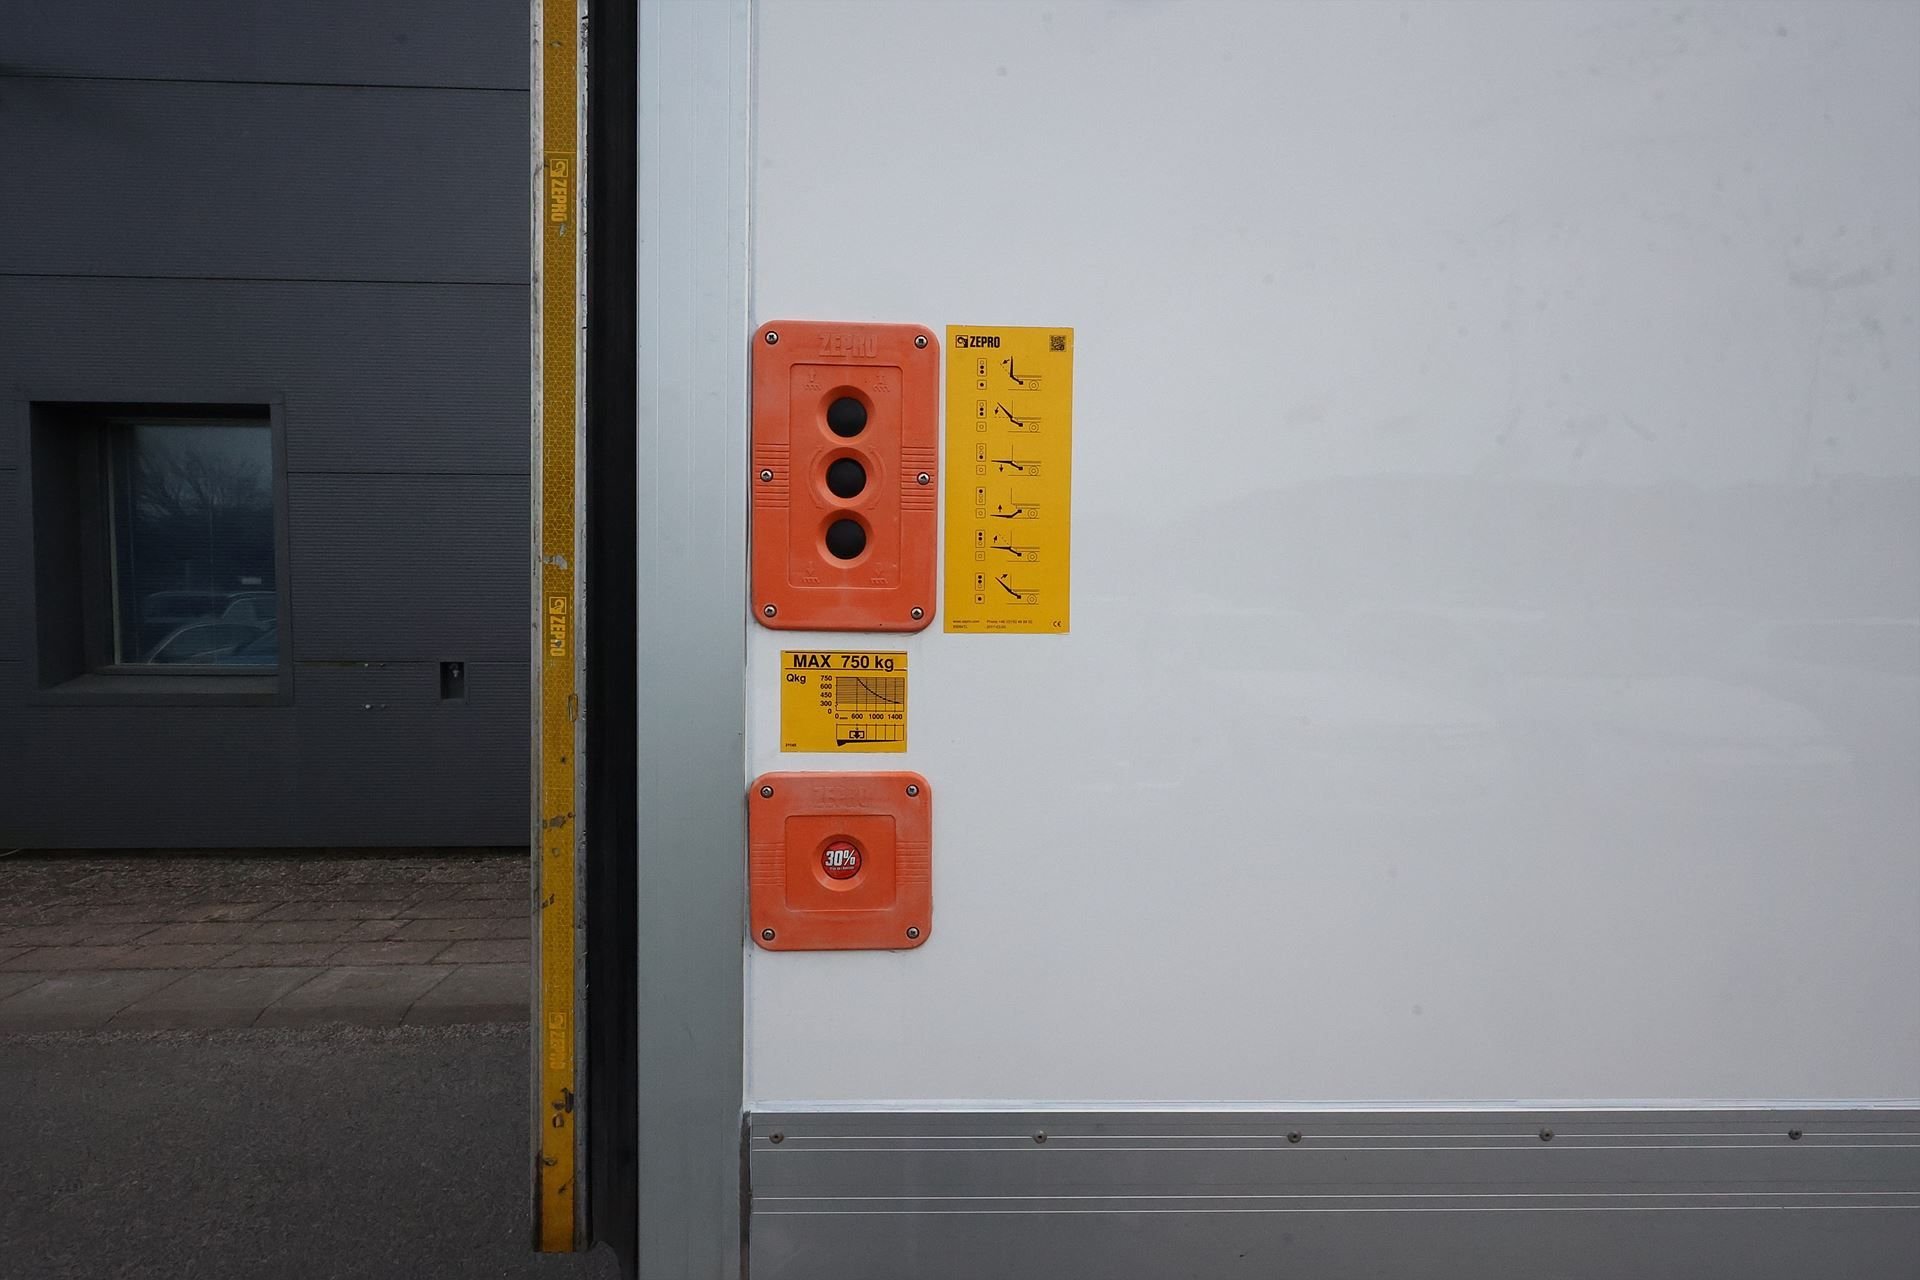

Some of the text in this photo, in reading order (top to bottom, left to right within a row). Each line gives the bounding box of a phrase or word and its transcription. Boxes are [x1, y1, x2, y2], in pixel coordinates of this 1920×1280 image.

[551, 179, 568, 222] ZEPRO
[818, 333, 878, 358] ZEPRO
[969, 336, 1001, 348] ZEPRO
[550, 616, 566, 657] ZEPRO
[793, 654, 894, 672] MAX 750 kg
[786, 673, 806, 684] Qkg
[825, 849, 856, 867] 30%
